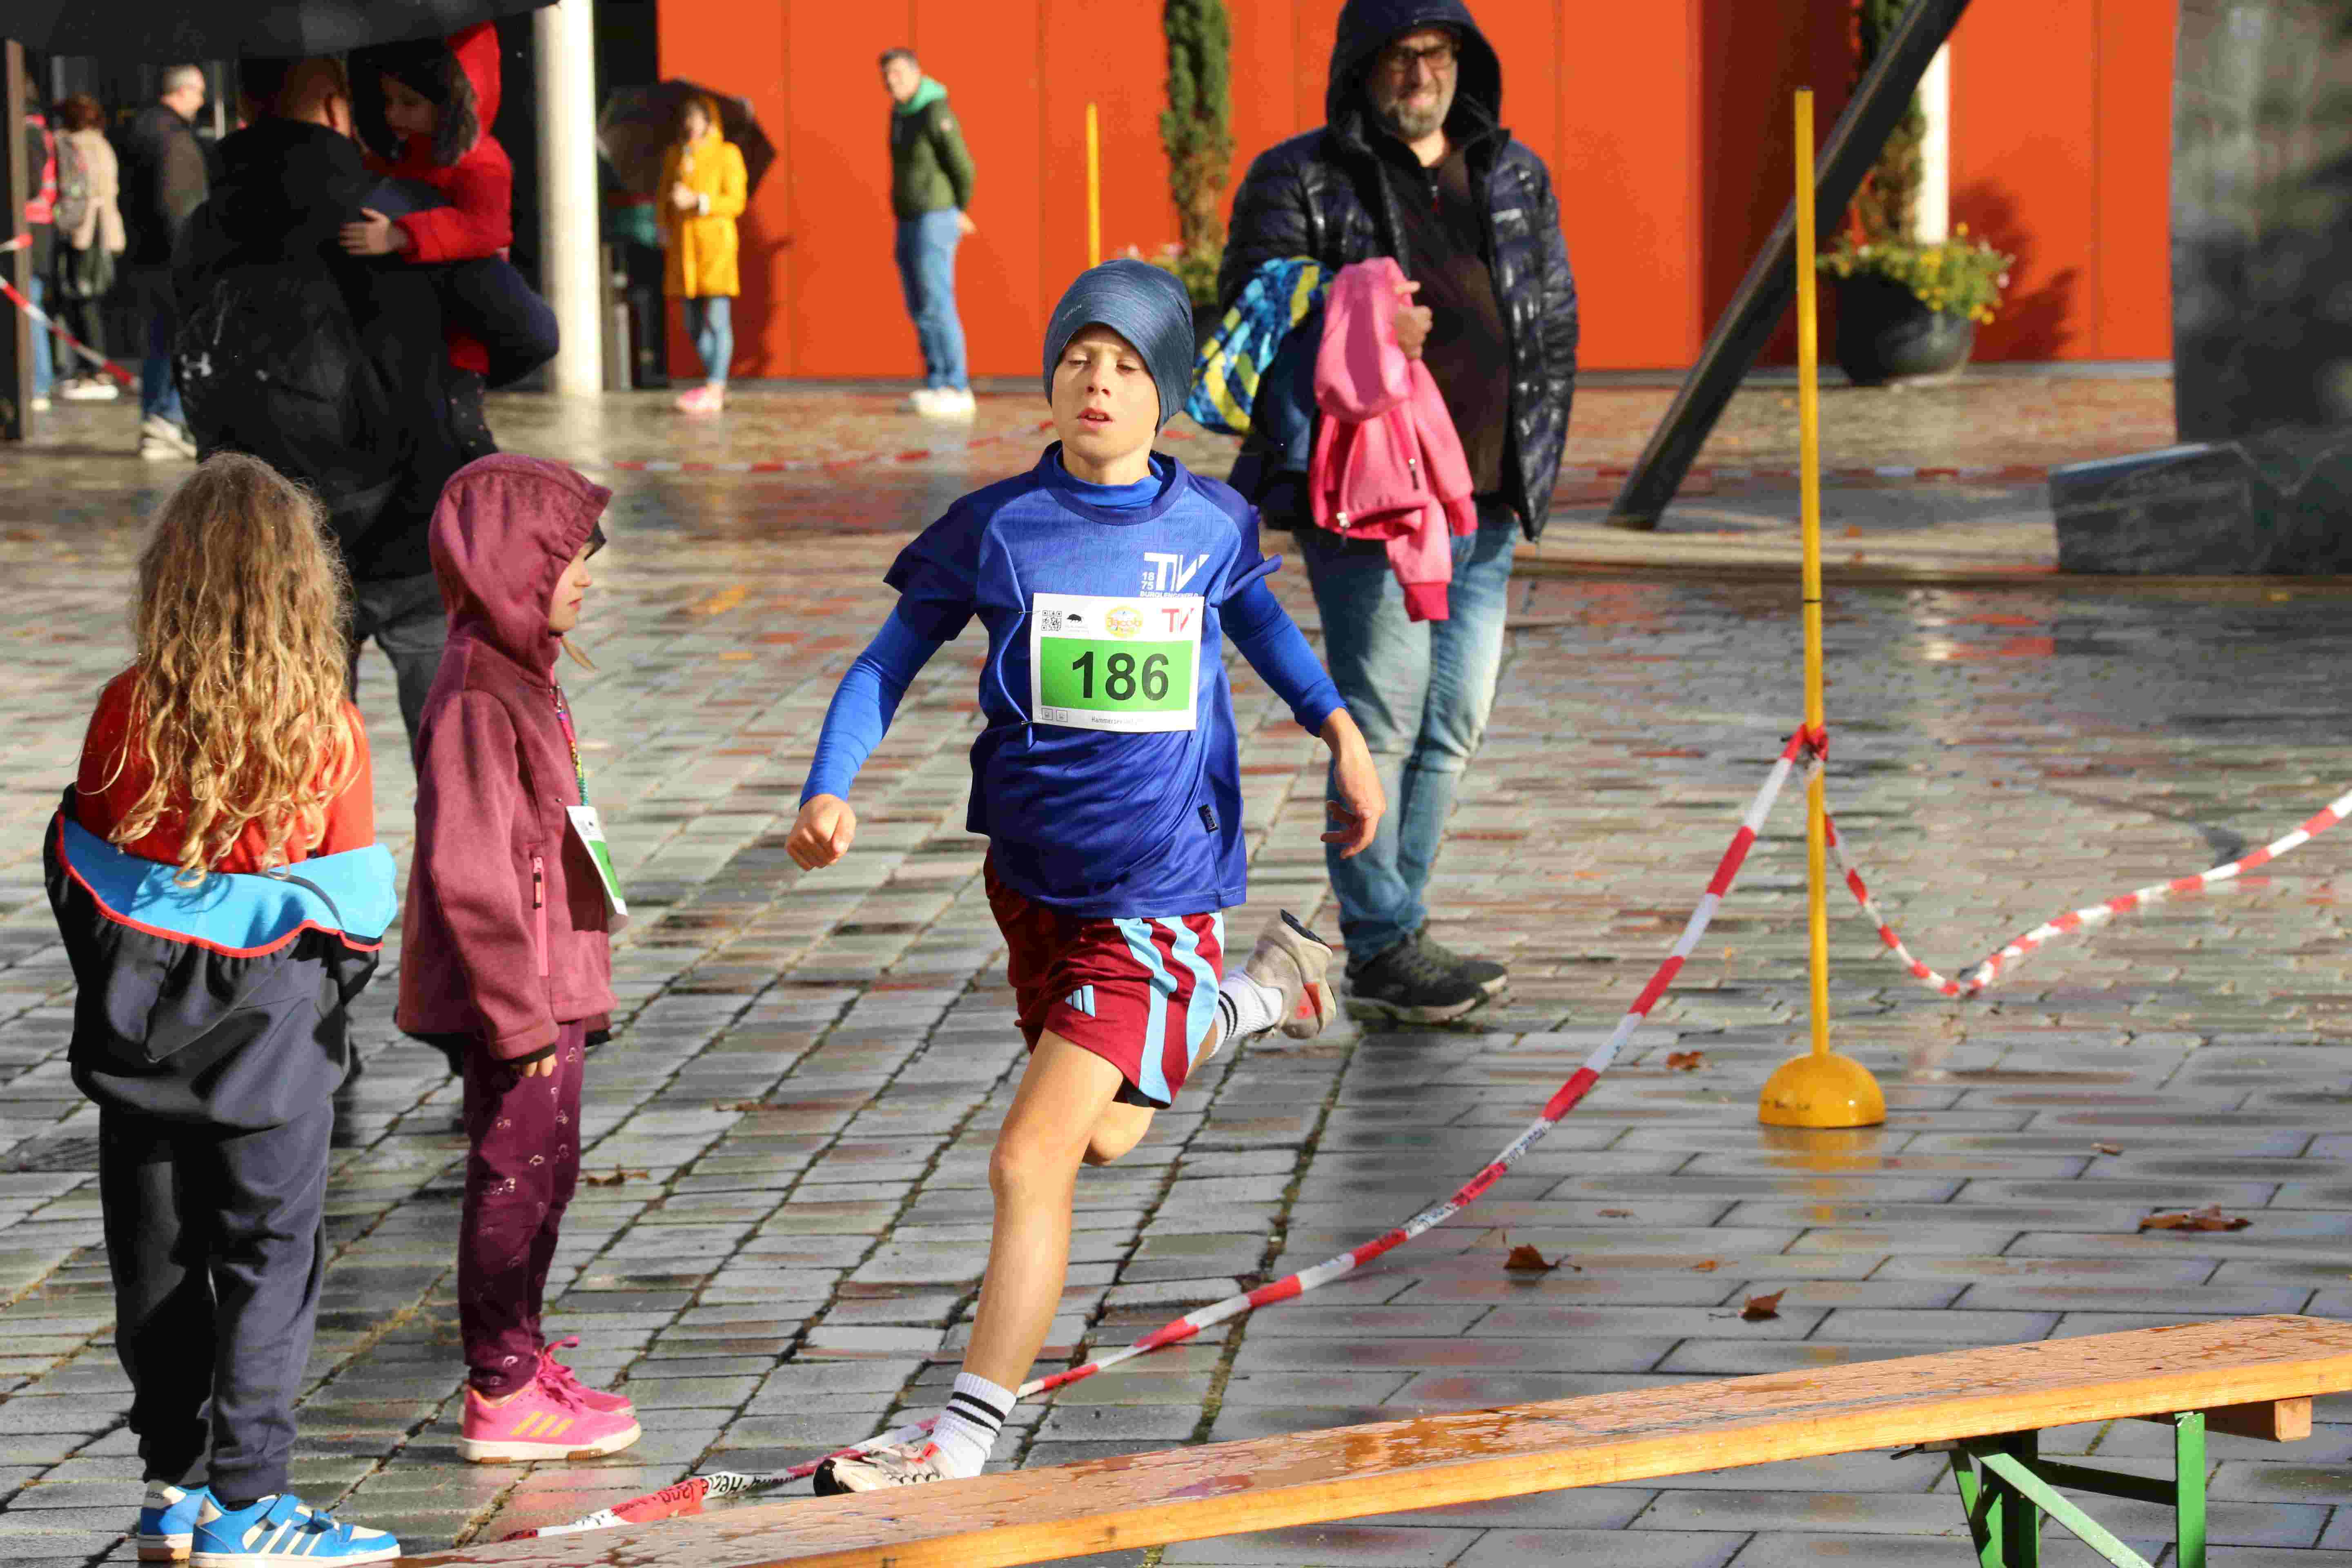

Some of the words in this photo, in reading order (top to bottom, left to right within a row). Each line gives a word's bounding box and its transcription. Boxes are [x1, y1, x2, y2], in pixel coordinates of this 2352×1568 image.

[1142, 572, 1155, 581] 18
[1144, 552, 1210, 592] TV
[1141, 581, 1154, 590] 75
[1072, 651, 1169, 701] 186
